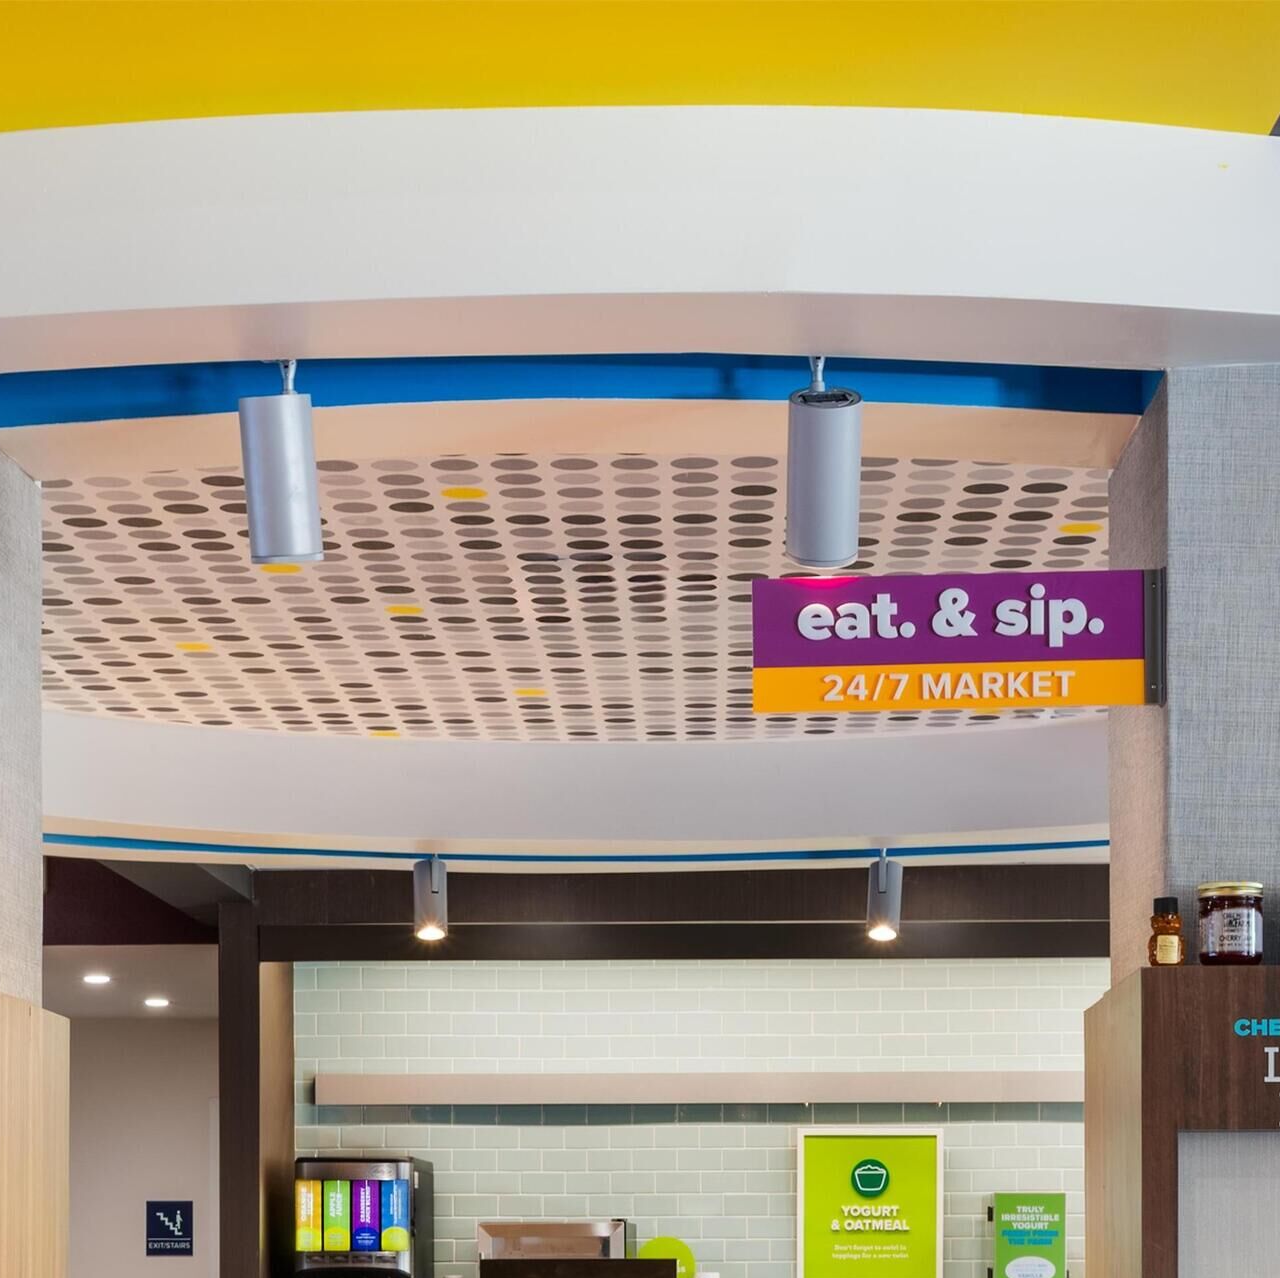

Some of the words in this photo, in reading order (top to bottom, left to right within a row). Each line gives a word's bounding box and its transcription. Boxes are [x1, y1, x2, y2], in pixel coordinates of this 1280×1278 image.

[797, 592, 916, 641] eat.
[931, 587, 978, 637] &
[995, 582, 1105, 648] sip.
[822, 672, 911, 702] 24/7
[921, 670, 1076, 701] MARKET
[841, 1205, 900, 1218] YOGURT
[1001, 1213, 1060, 1221] IRRESISTIBLE
[831, 1220, 841, 1231] &
[843, 1219, 910, 1231] OATMEAL
[1011, 1222, 1049, 1230] YOGURT
